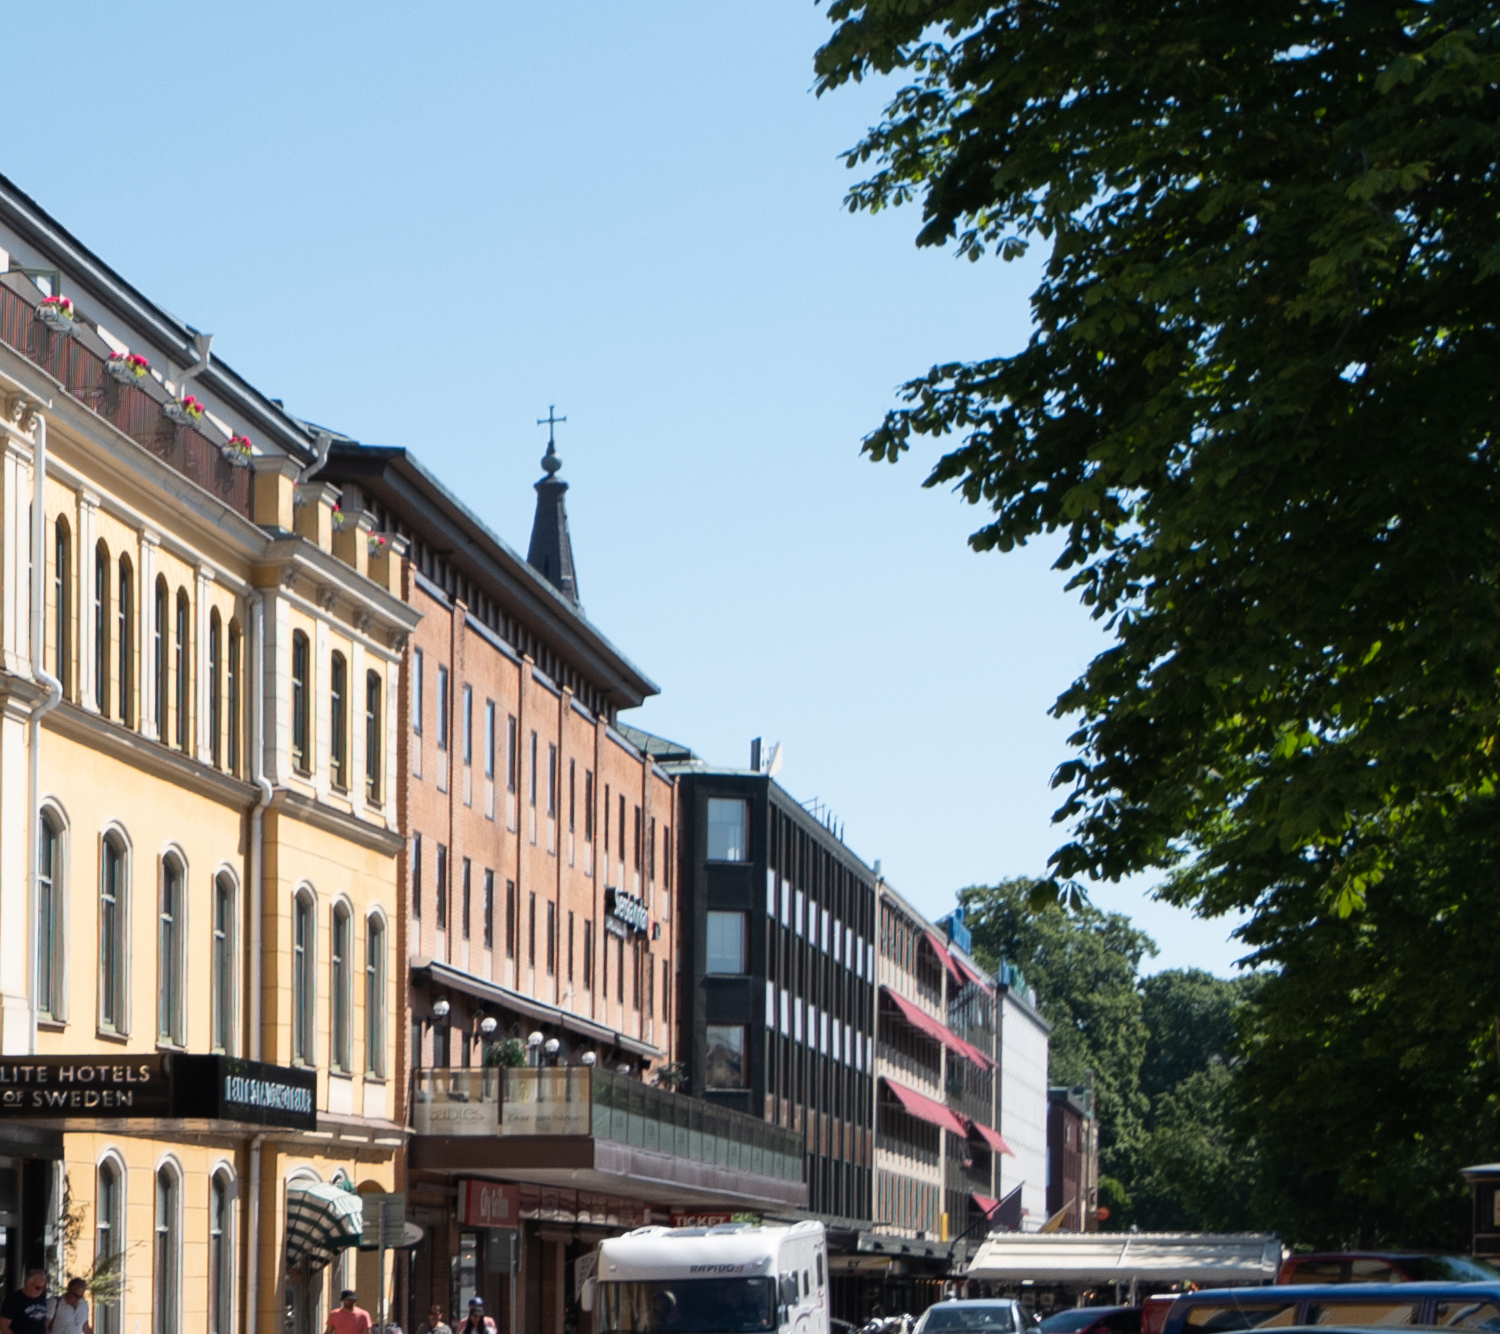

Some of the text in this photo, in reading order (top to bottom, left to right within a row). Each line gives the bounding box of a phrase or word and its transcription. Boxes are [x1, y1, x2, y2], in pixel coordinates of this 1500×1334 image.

[58, 1065, 150, 1083] HOTELS
[2, 1090, 133, 1108] OF SWEDEN
[674, 1216, 727, 1227] TICKET
